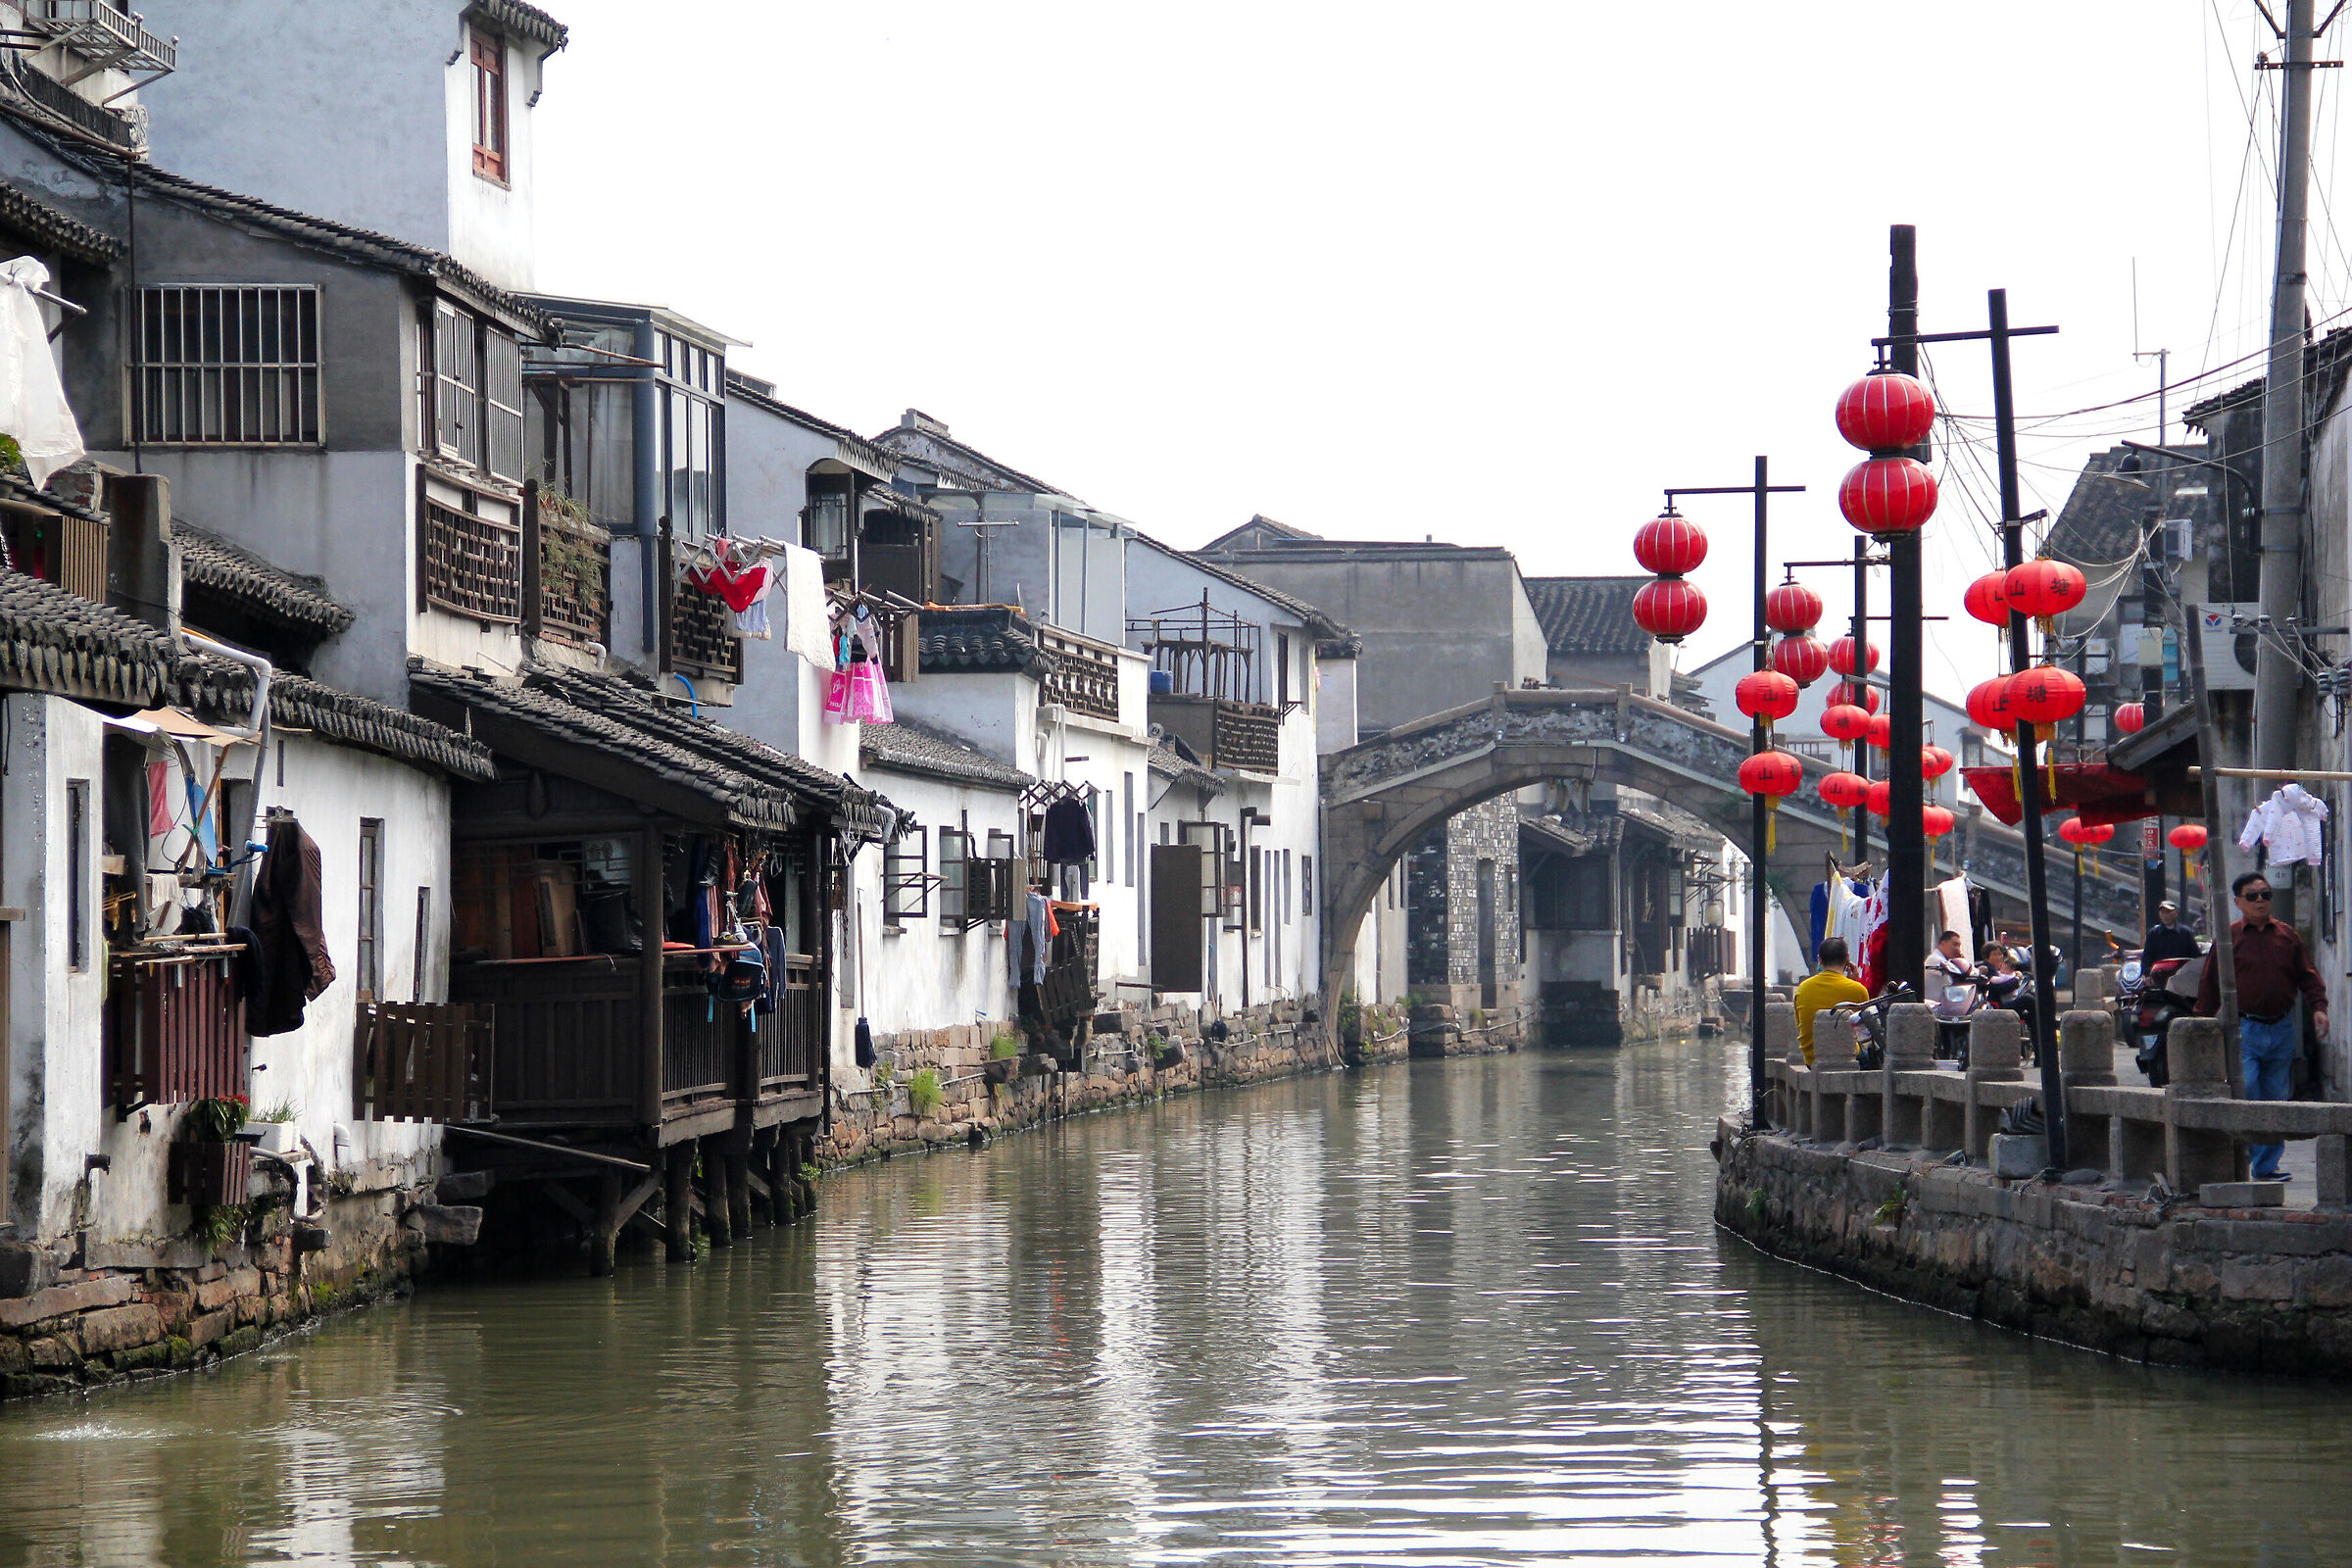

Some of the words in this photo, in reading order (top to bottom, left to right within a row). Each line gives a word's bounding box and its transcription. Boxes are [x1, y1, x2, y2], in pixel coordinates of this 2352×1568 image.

[2010, 579, 2026, 596] 山
[1764, 688, 1779, 701] 山
[1757, 767, 1773, 780] 山
